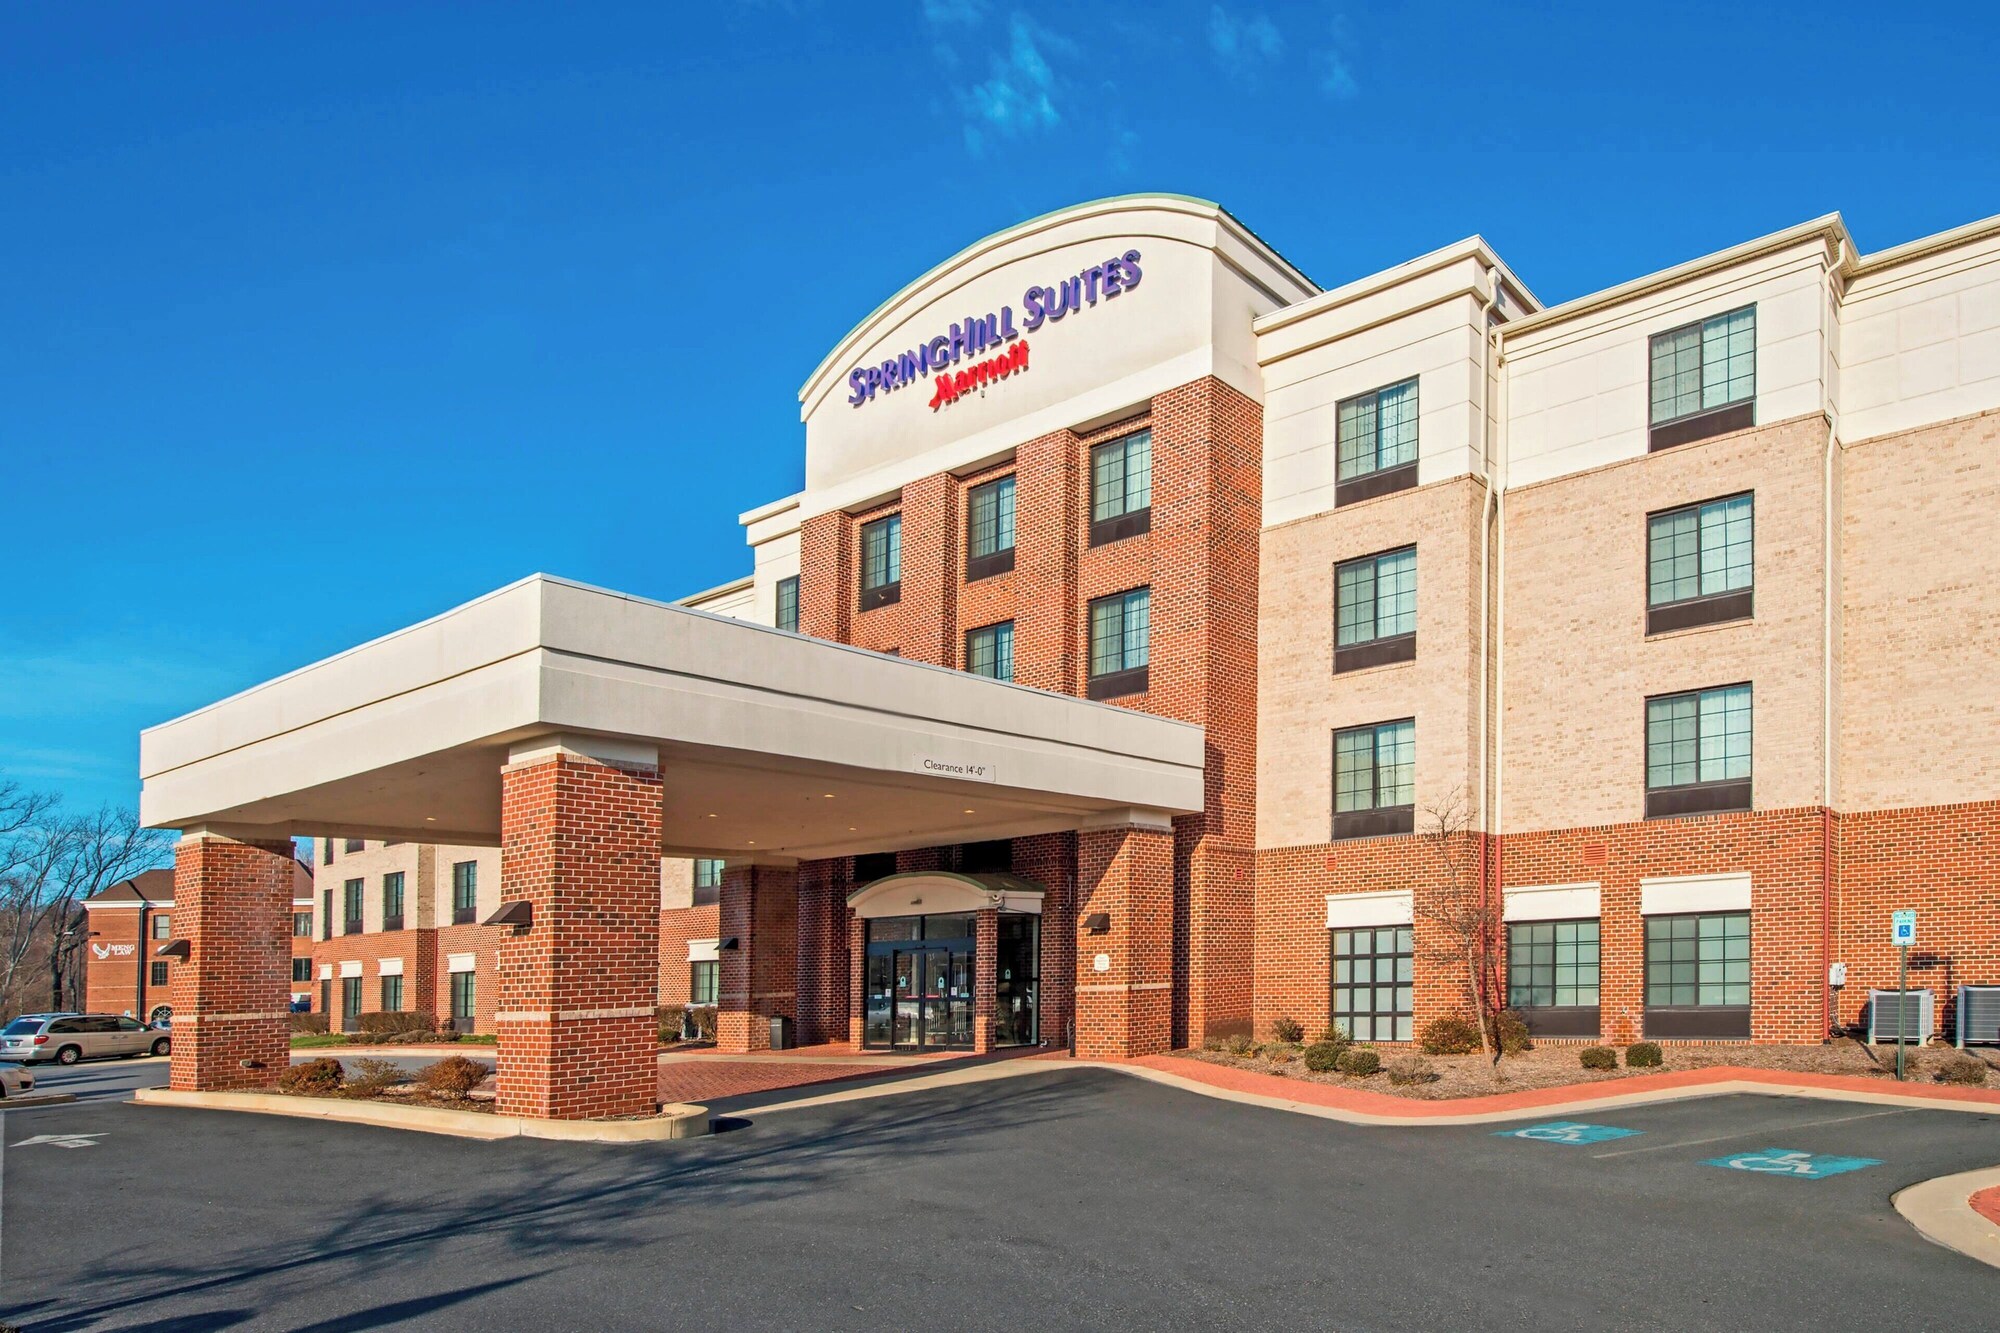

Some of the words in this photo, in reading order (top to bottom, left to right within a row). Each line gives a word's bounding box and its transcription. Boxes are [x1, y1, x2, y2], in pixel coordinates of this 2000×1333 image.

[848, 305, 1018, 407] SPRINGHILL
[1022, 249, 1142, 331] SUITES
[928, 338, 1030, 411] Marriott
[923, 759, 963, 774] Clearance
